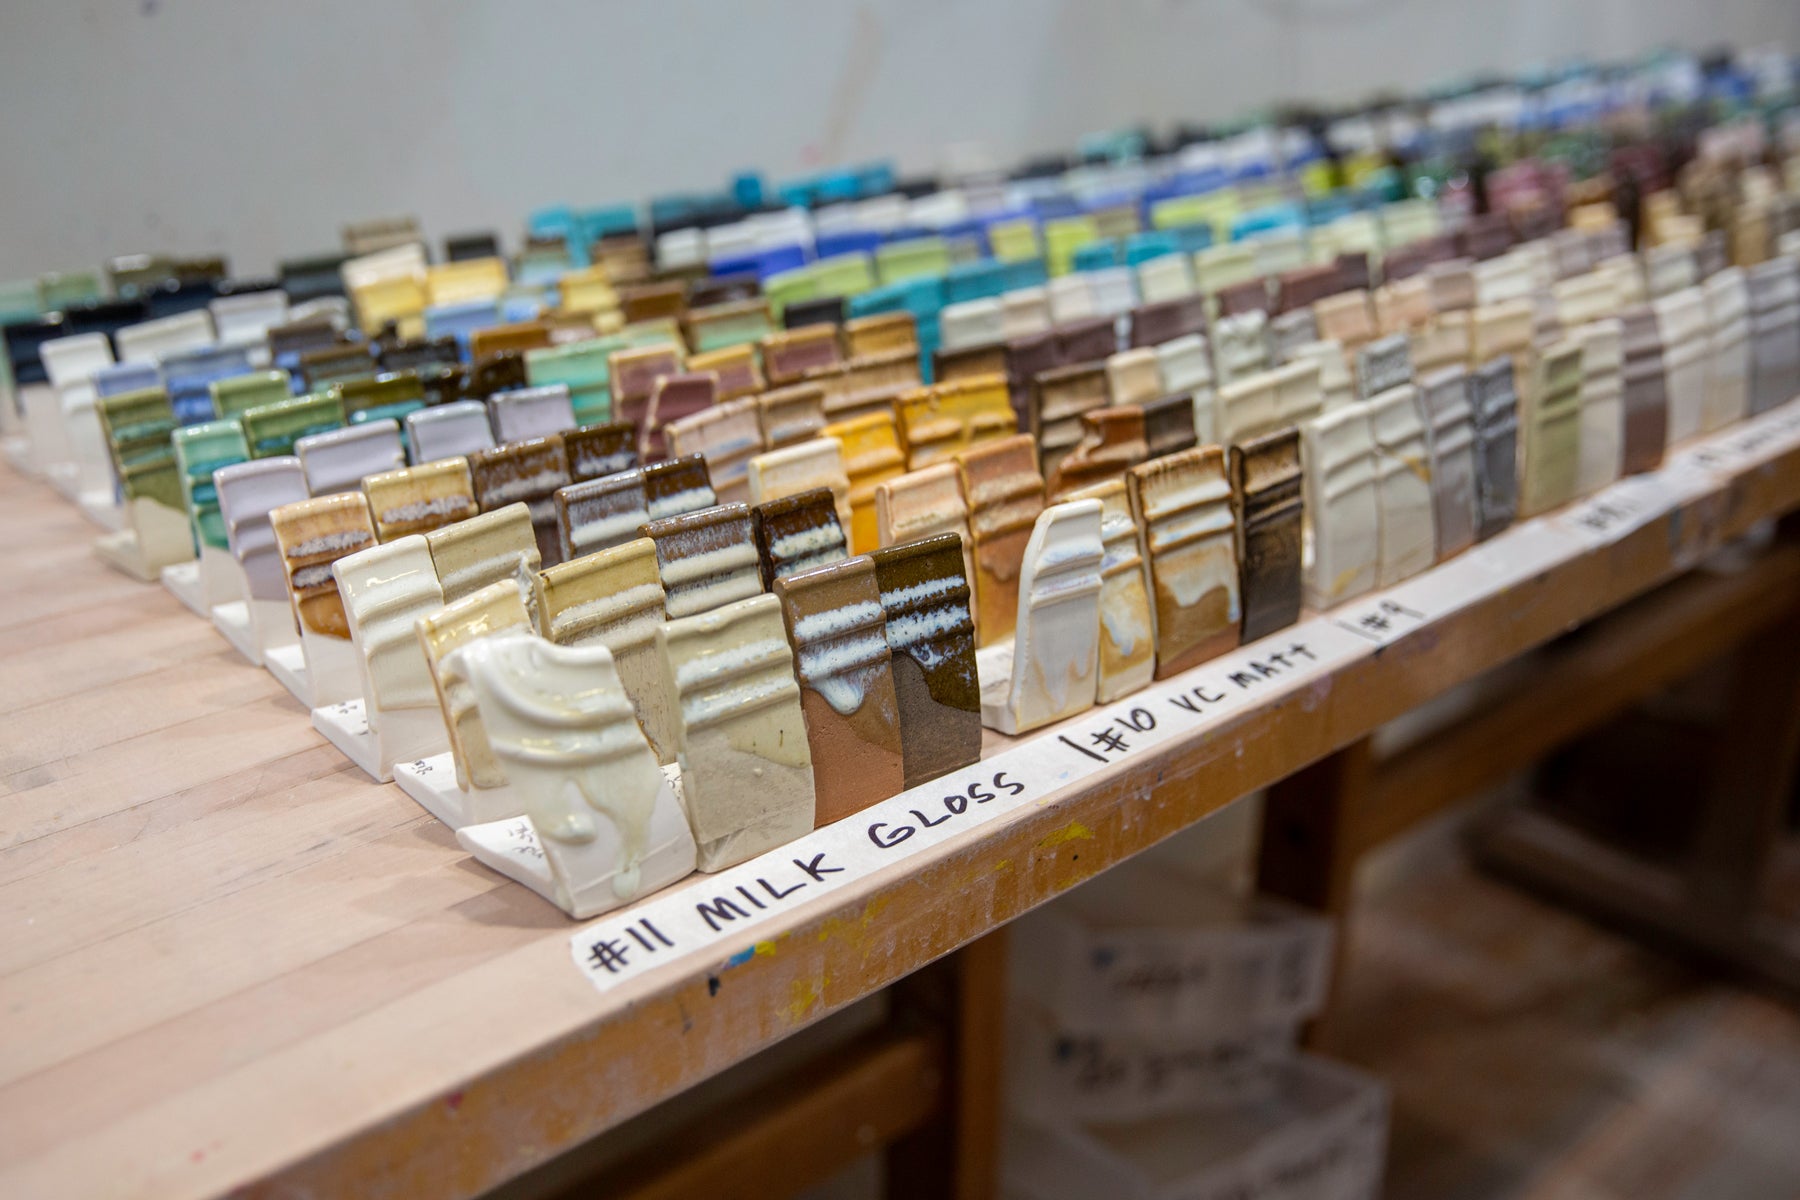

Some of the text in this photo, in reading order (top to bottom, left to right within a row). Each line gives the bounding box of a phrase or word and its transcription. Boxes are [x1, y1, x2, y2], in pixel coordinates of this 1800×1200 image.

[1091, 642, 1318, 753] #10 VC MATT
[586, 771, 1025, 973] #11 MILK GLOSS
